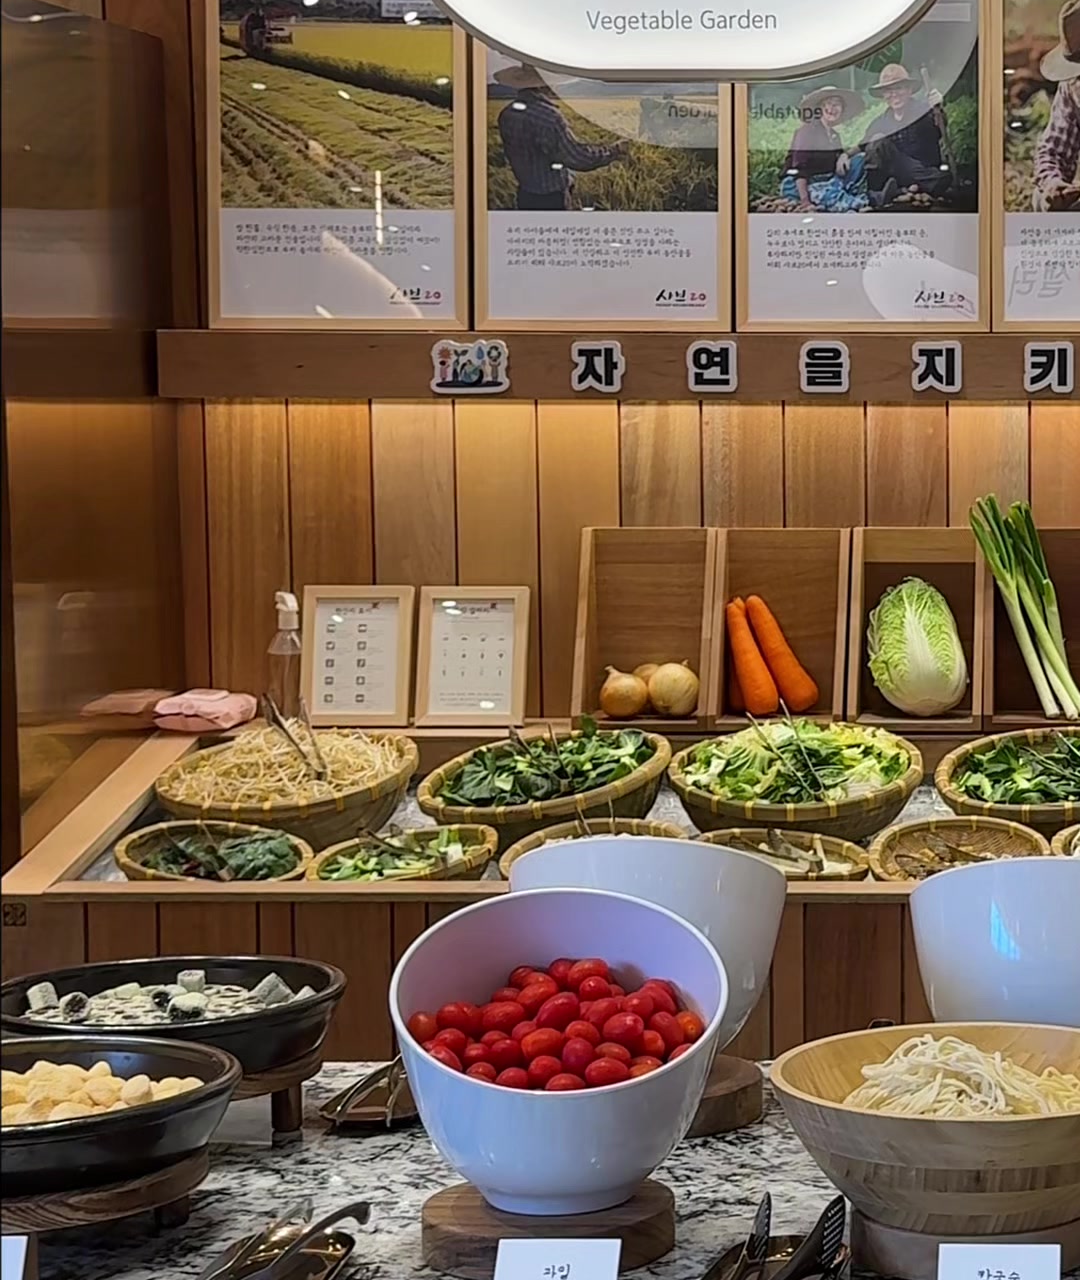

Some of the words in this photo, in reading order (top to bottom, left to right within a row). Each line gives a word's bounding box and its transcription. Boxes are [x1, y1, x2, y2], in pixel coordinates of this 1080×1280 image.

[586, 9, 693, 35] Vegetable
[700, 8, 777, 30] Garden
[543, 1263, 571, 1280] 과일
